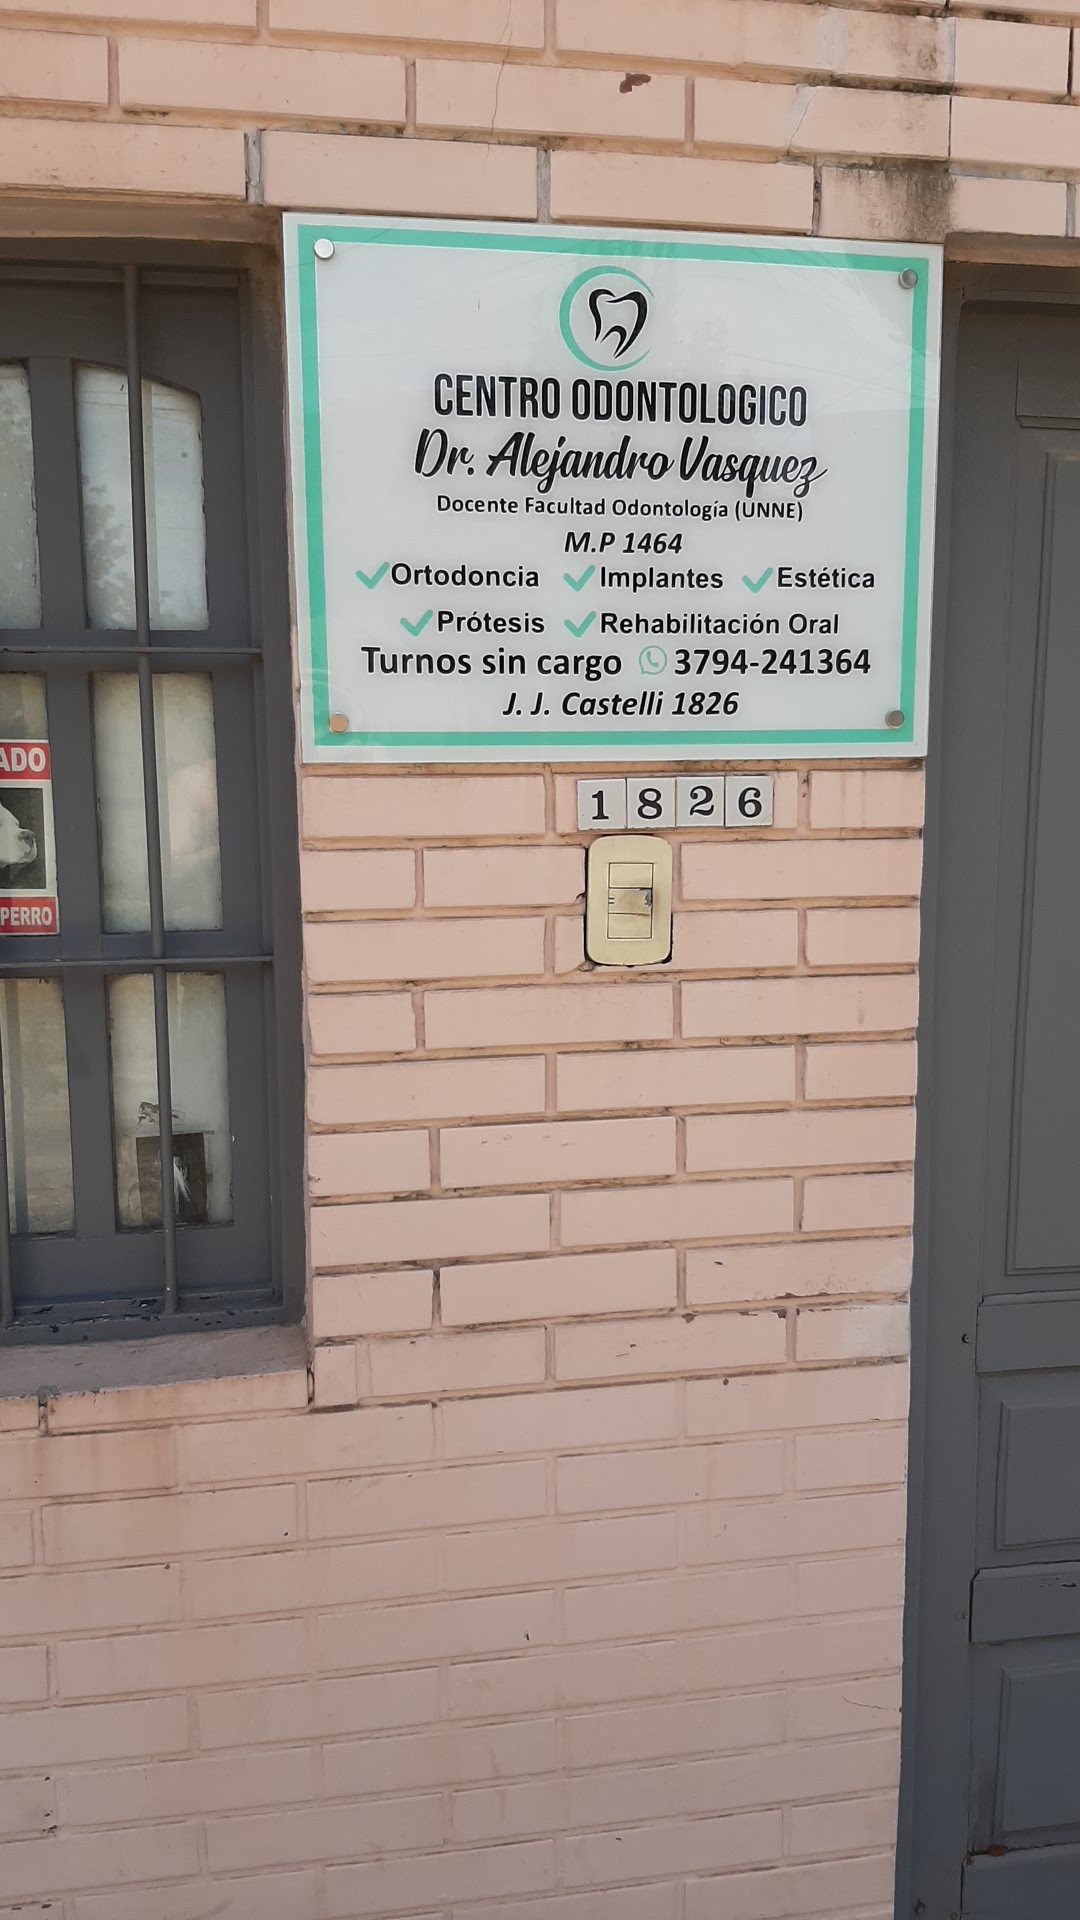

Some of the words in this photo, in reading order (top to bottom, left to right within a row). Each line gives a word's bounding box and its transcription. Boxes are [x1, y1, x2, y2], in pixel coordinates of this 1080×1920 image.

[434, 373, 561, 420] CENTRO
[571, 378, 807, 427] ODONTOLOGICO
[414, 428, 475, 480] Dr.
[485, 431, 676, 494] Alejandro
[679, 435, 829, 499] Vasquez
[437, 494, 519, 514] Docente
[525, 496, 606, 516] Facultad
[612, 498, 728, 522] Odontología
[735, 500, 803, 523] (UNNE)
[564, 531, 616, 553] M.P
[622, 532, 683, 554] 1464
[391, 562, 539, 588] Ortodoncia
[600, 566, 724, 594] Implantes
[777, 566, 875, 589] Estética
[437, 610, 545, 634] Prótesis
[600, 612, 780, 635] Rehabilitación
[788, 613, 839, 635] Oral
[360, 646, 472, 675] Turnos
[482, 646, 526, 675] sin
[537, 654, 622, 682] cargo
[674, 648, 871, 675] 3794-241364
[502, 692, 522, 716] J.
[530, 691, 550, 716] J.
[561, 690, 664, 716] Castelli
[671, 691, 740, 716] 1826
[591, 785, 763, 820] 1826
[0, 907, 53, 926] PERRO
